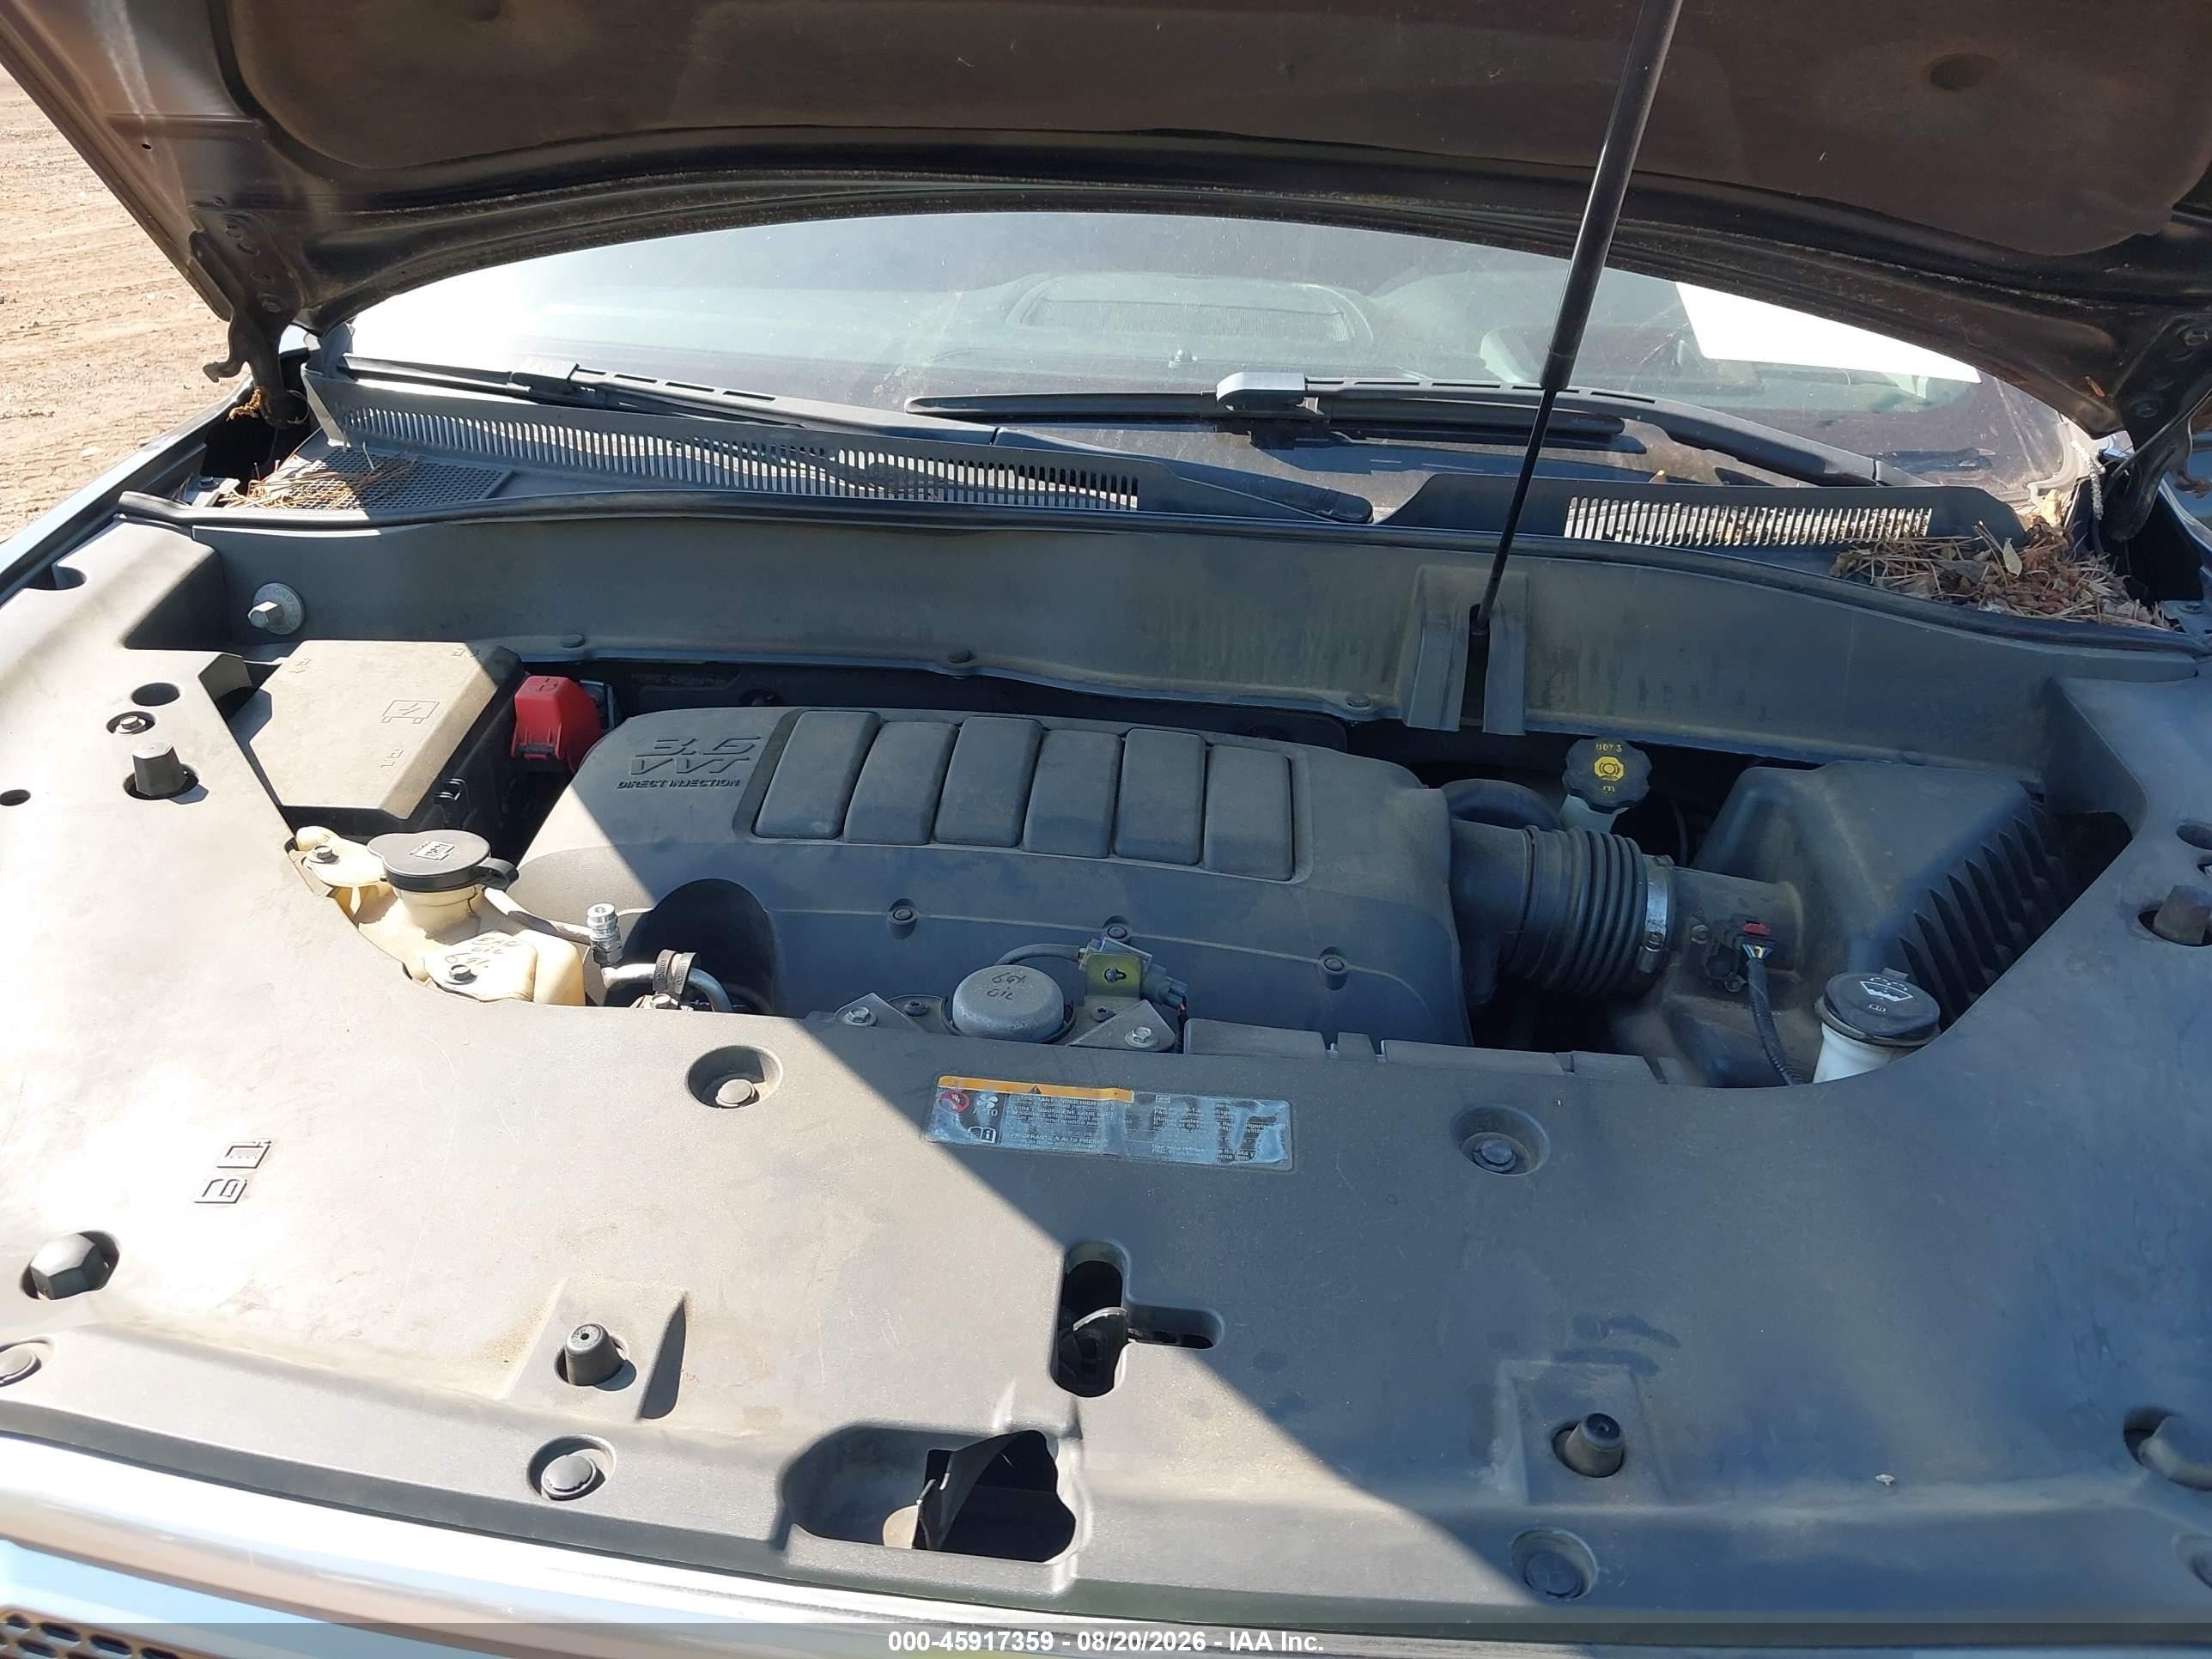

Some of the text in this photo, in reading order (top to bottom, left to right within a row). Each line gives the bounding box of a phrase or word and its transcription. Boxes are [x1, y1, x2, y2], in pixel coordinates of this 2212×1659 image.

[635, 736, 761, 757] 3.6
[630, 757, 750, 775] VVT
[617, 779, 740, 789] DIRECT INJECTION
